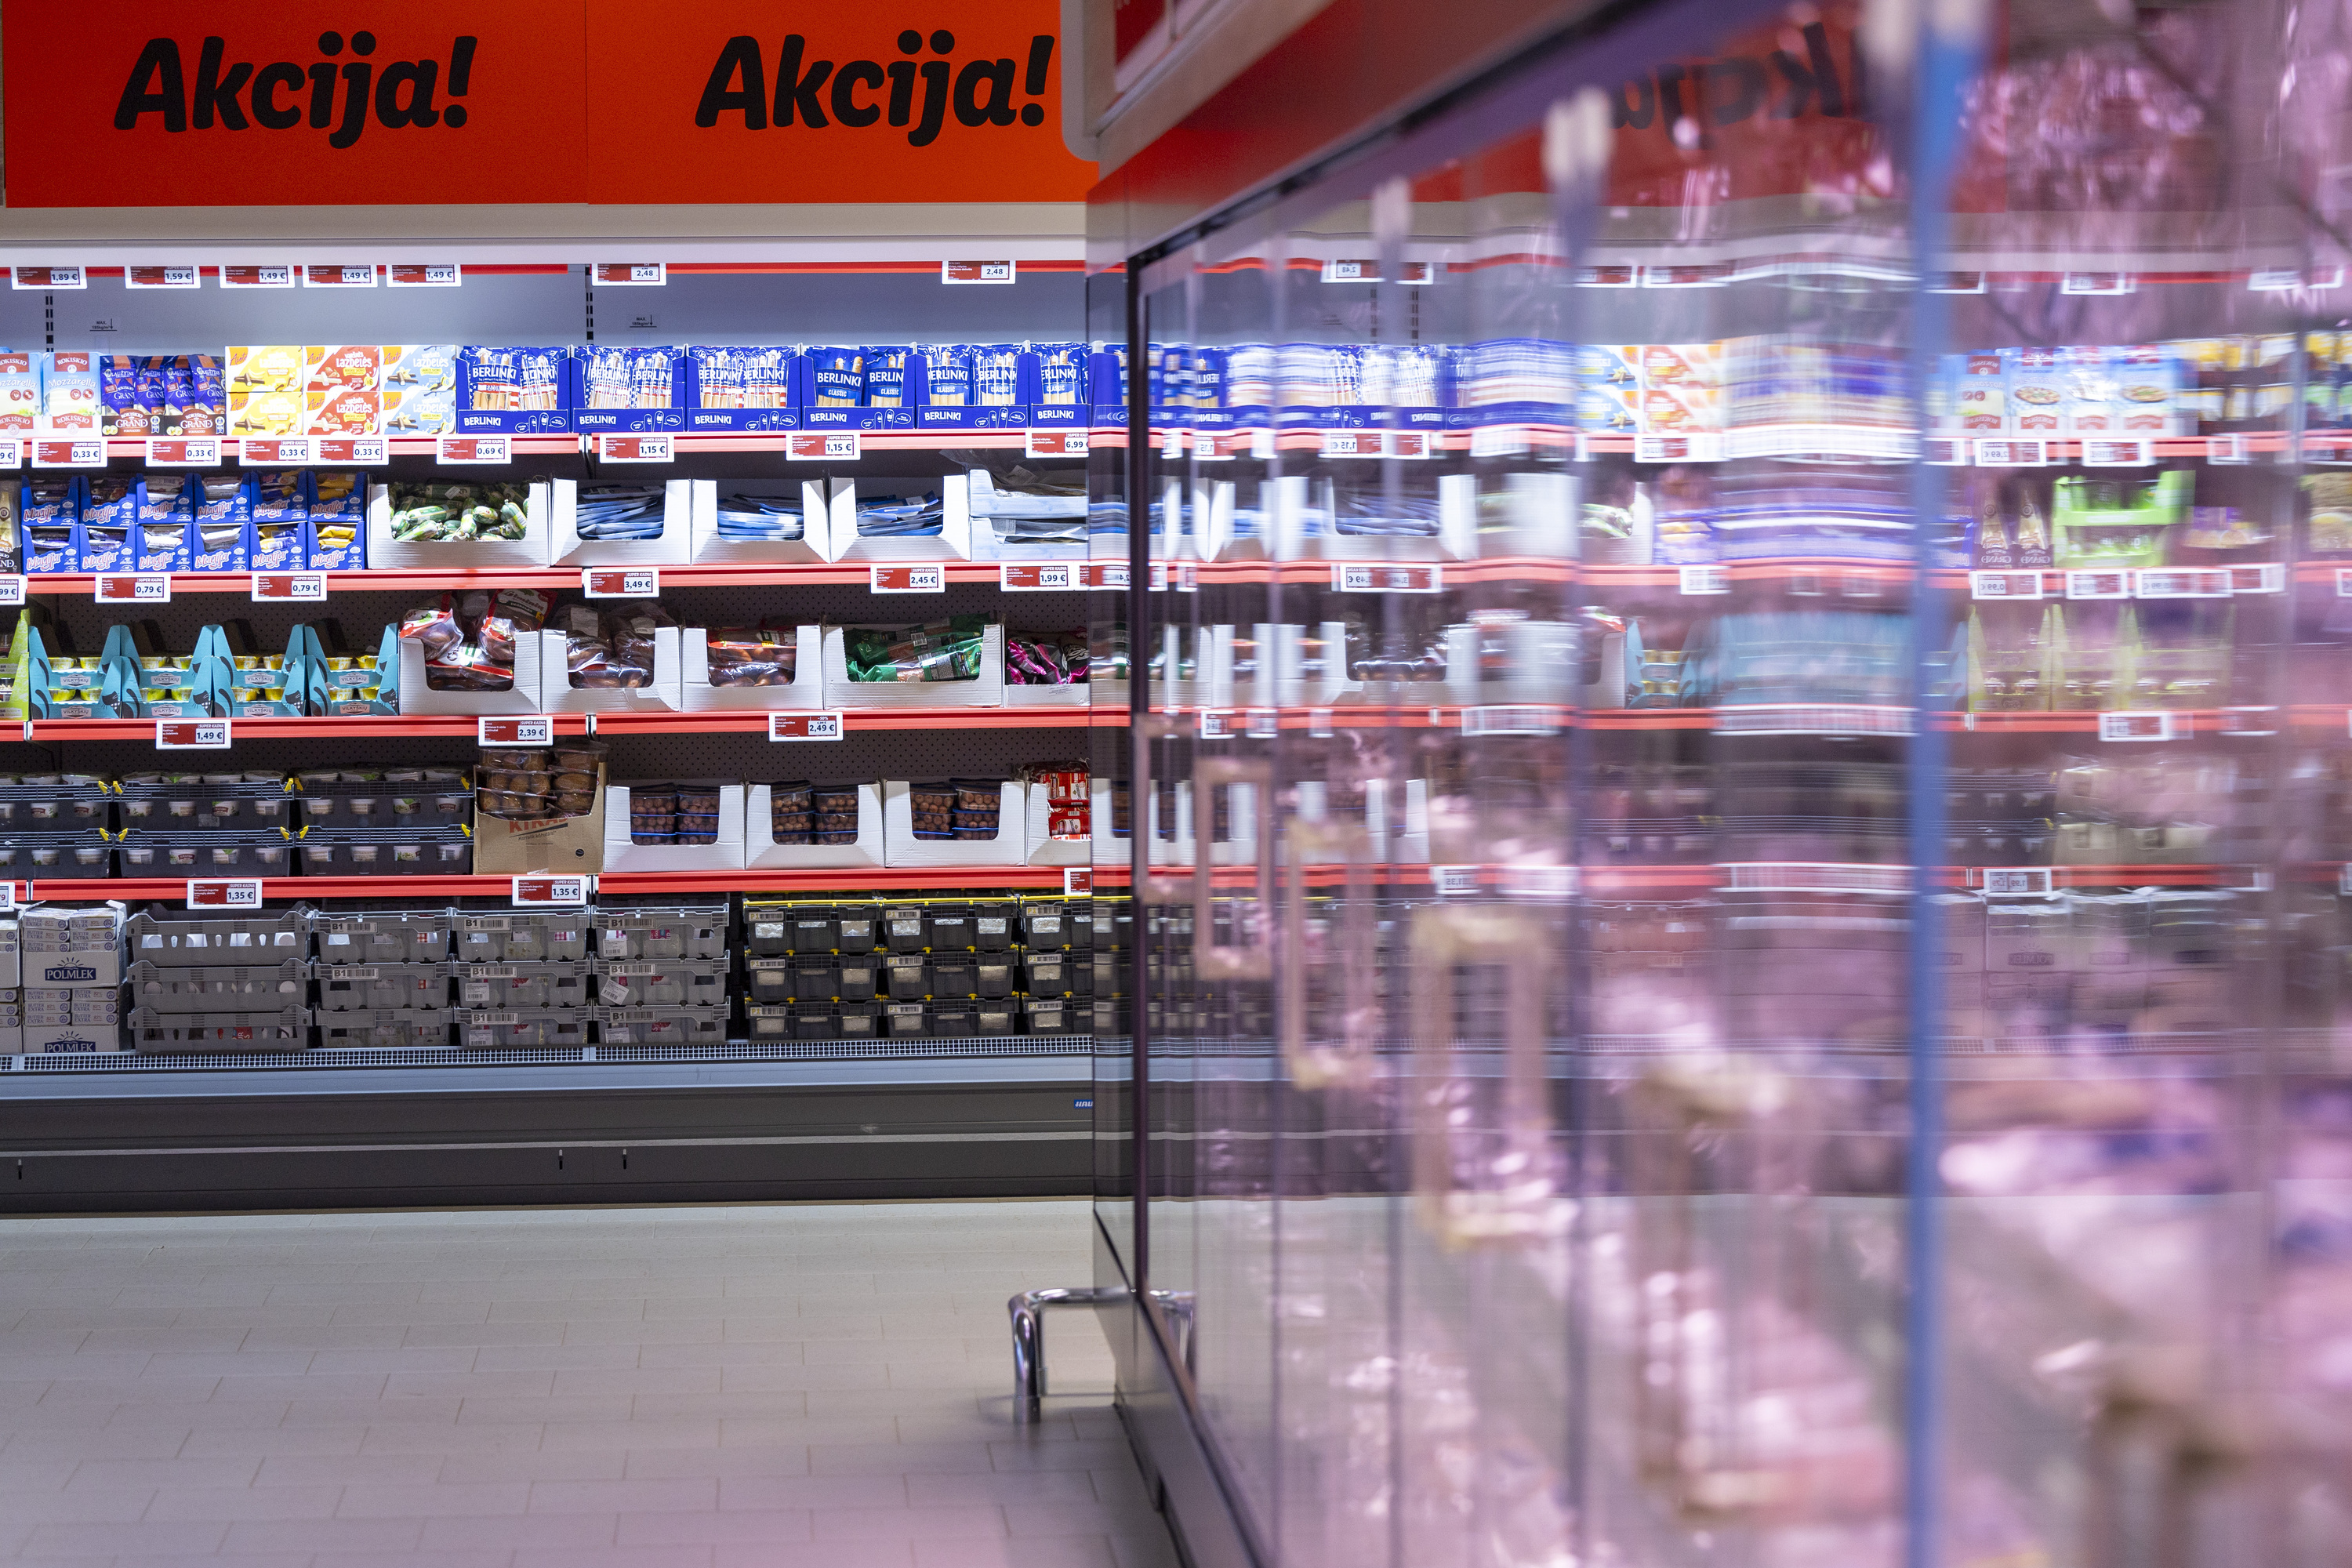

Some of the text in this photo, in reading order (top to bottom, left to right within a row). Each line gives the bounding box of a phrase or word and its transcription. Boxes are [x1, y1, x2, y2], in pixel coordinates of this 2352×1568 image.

[114, 31, 477, 149] Akcija!
[695, 29, 1055, 147] Akcija!
[472, 366, 517, 379] BERLINKI
[869, 372, 903, 383] BERLIN
[978, 369, 1017, 381] BERLINK
[1042, 368, 1076, 380] ERLINKI
[48, 378, 96, 389] Mozzarella
[817, 372, 862, 387] BERLINKI
[828, 389, 847, 397] CLASSIC
[579, 415, 616, 425] BERLINKI
[694, 414, 731, 424] BERLINKI
[810, 412, 847, 423] BERLINKI
[924, 412, 961, 421] BERLINKI
[1036, 410, 1074, 420] BERLINKI
[116, 419, 148, 429] GRAND
[180, 419, 212, 429] GRAND
[463, 416, 501, 426] BERLINKI
[24, 504, 60, 524] Magija
[83, 504, 120, 524] Magija
[139, 501, 176, 521] Magija
[197, 500, 234, 521] Magija
[253, 499, 290, 521] Magija
[310, 500, 347, 520] Magija
[26, 552, 63, 572] Magija
[82, 551, 118, 571] Magija
[138, 551, 175, 571] Magija
[195, 550, 232, 569] Magija
[252, 550, 289, 568] Magija
[310, 550, 347, 568] Magija
[911, 576, 928, 585] 2,45
[228, 891, 245, 900] 1,35
[553, 887, 569, 896] 1,35
[465, 919, 477, 927] B1
[612, 919, 622, 927] B1
[47, 970, 93, 980] POLMLEK
[47, 1044, 93, 1053] POLMLEK
